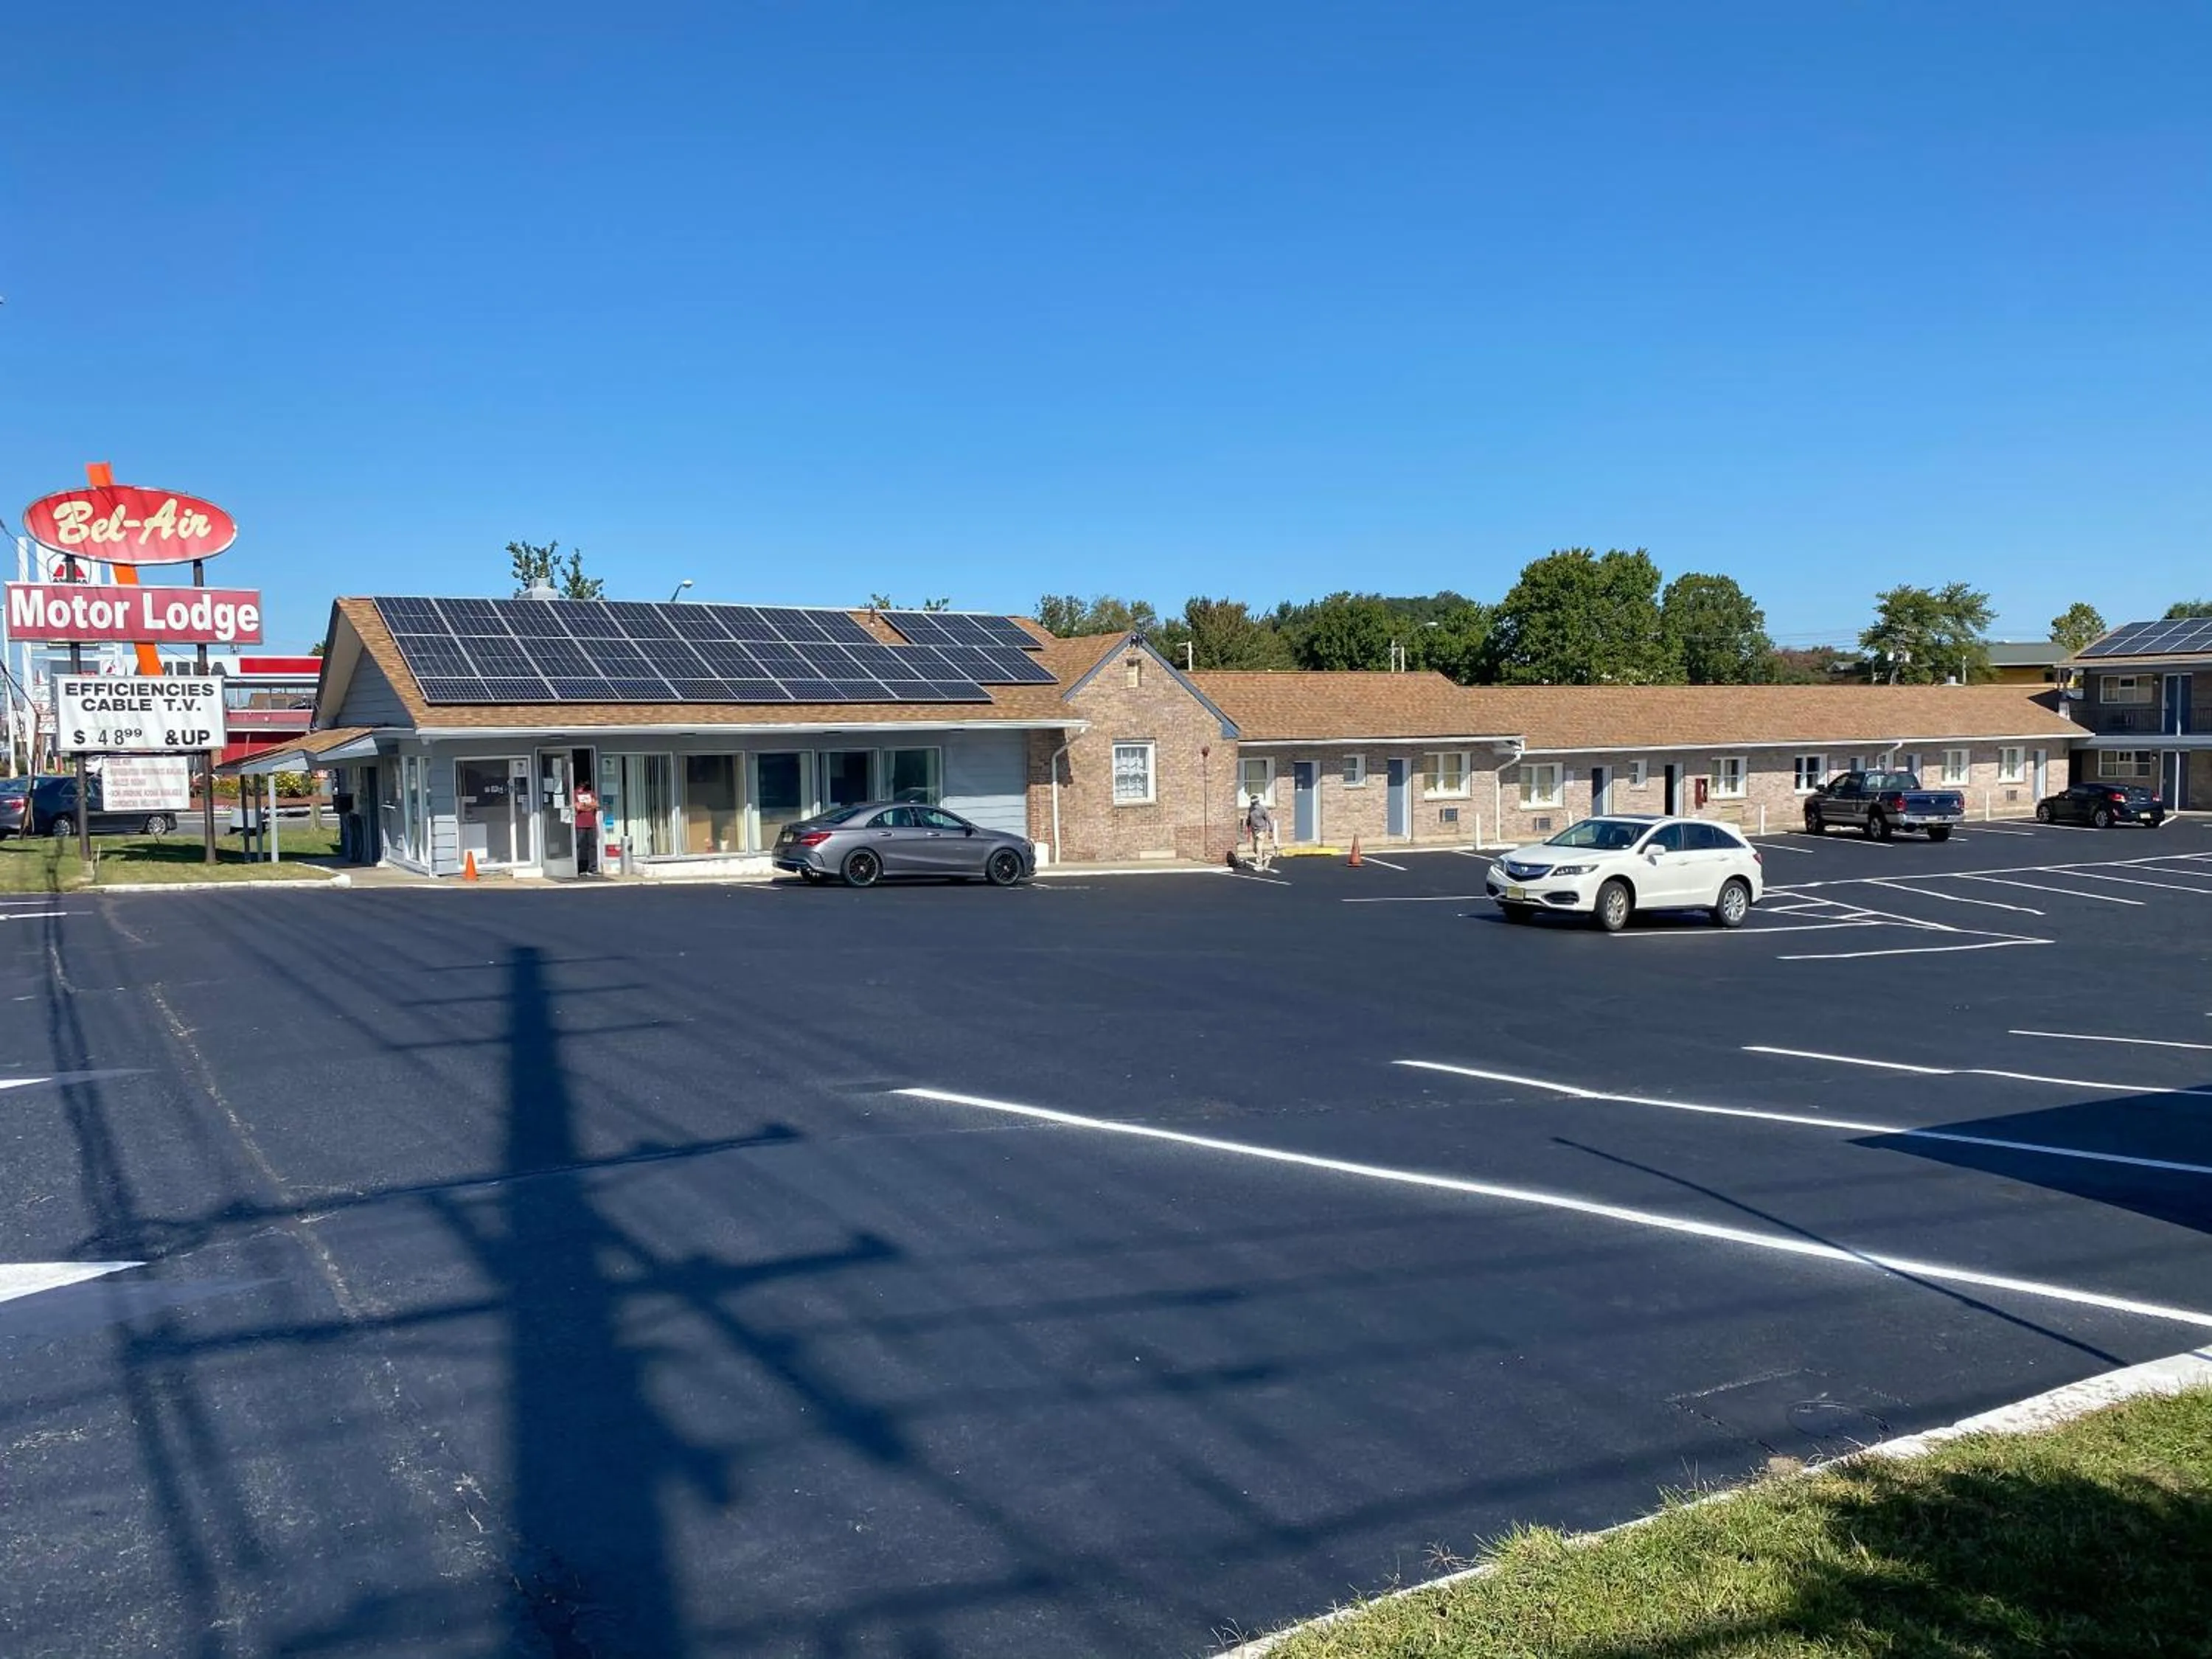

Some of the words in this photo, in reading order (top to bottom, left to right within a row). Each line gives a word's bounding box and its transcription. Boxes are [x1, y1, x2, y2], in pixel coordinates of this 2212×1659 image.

[52, 498, 212, 546] Bel-Air
[10, 589, 131, 630] Motor
[142, 592, 260, 641] Lodge
[65, 683, 215, 697] EFFICIENCIES
[81, 698, 153, 712] CABLE
[163, 698, 201, 712] T.V.
